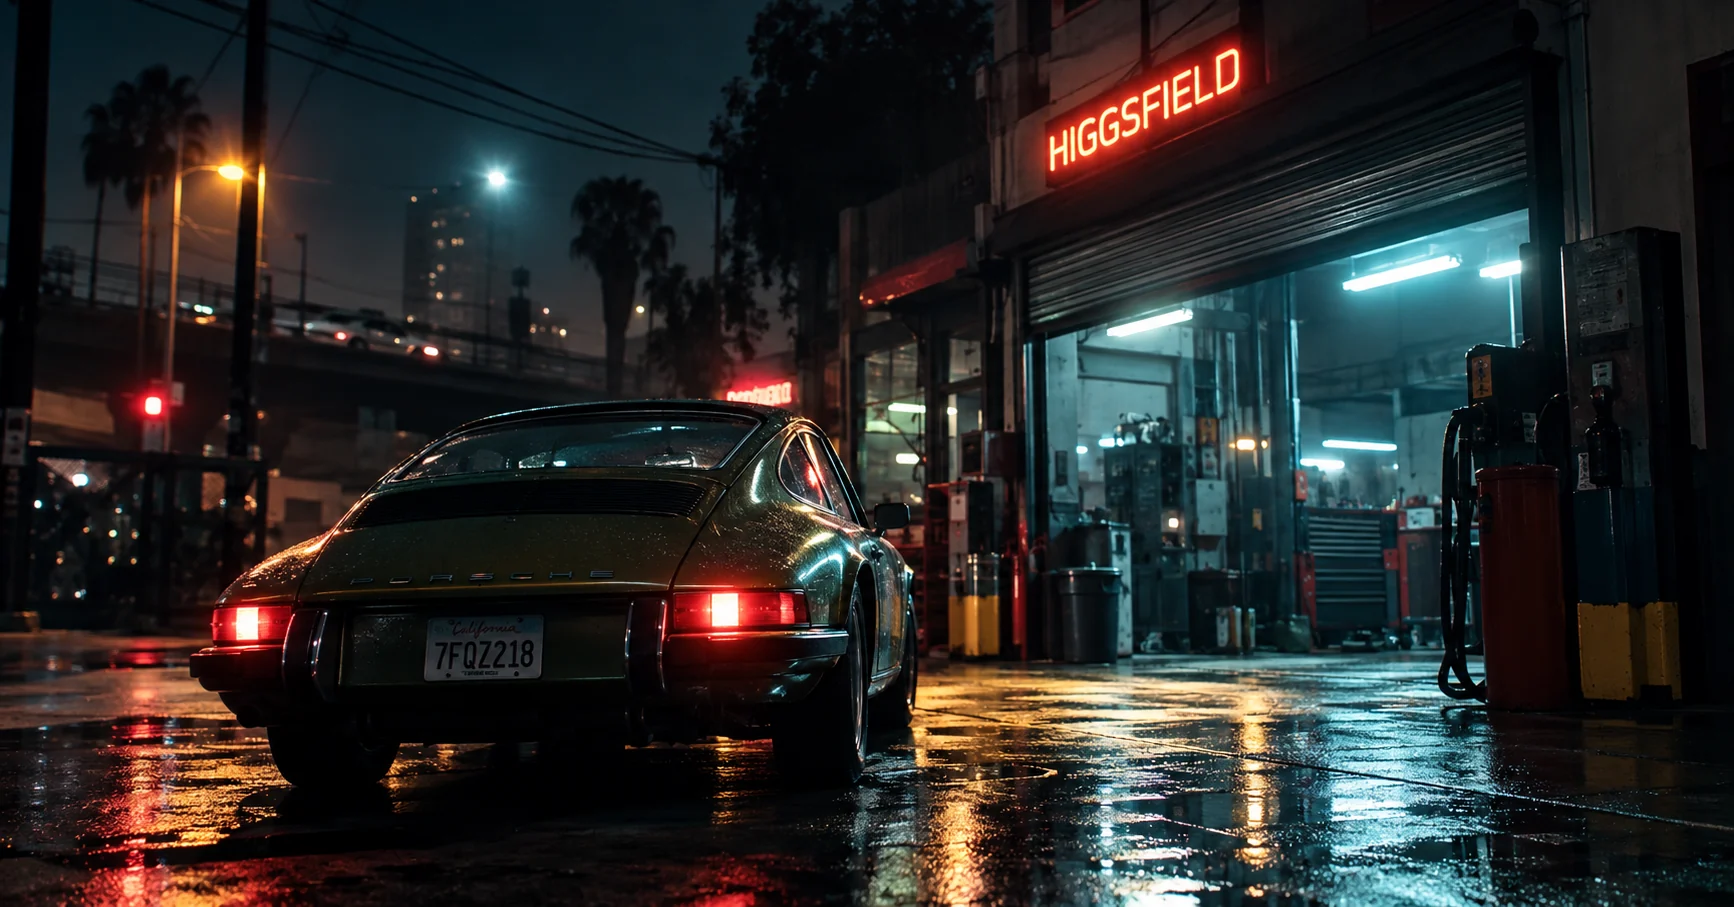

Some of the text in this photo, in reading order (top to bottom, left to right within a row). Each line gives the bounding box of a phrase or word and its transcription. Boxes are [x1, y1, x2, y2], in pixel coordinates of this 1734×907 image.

[1049, 48, 1240, 172] HIGGSFIELD
[350, 570, 614, 585] PORSCHE
[452, 619, 521, 639] California
[434, 639, 534, 670] 7FQZ218
